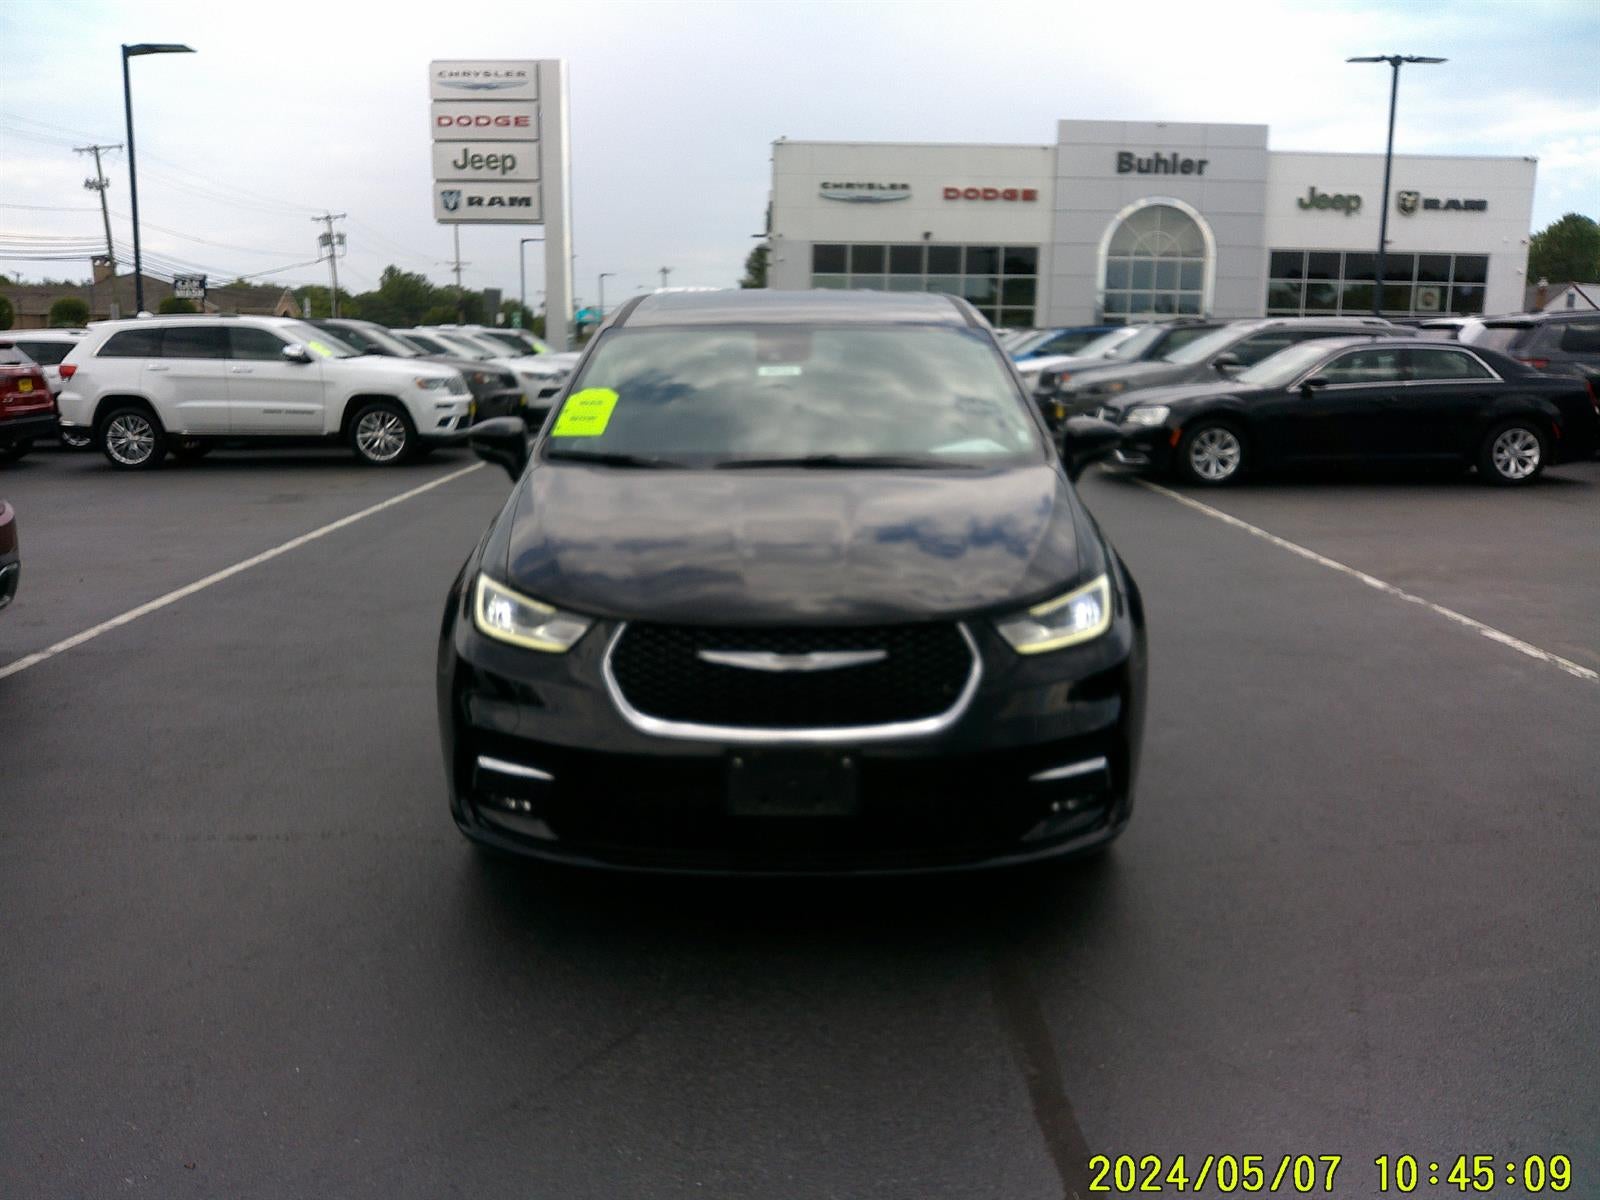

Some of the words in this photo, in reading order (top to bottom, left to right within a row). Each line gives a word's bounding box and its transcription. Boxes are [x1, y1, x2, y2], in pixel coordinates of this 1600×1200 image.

[437, 115, 530, 127] DODGE
[453, 148, 517, 175] Jeep
[1116, 152, 1208, 175] Buhler
[467, 196, 532, 207] RAM
[943, 187, 1038, 201] DODGE
[1298, 186, 1362, 216] Jeep
